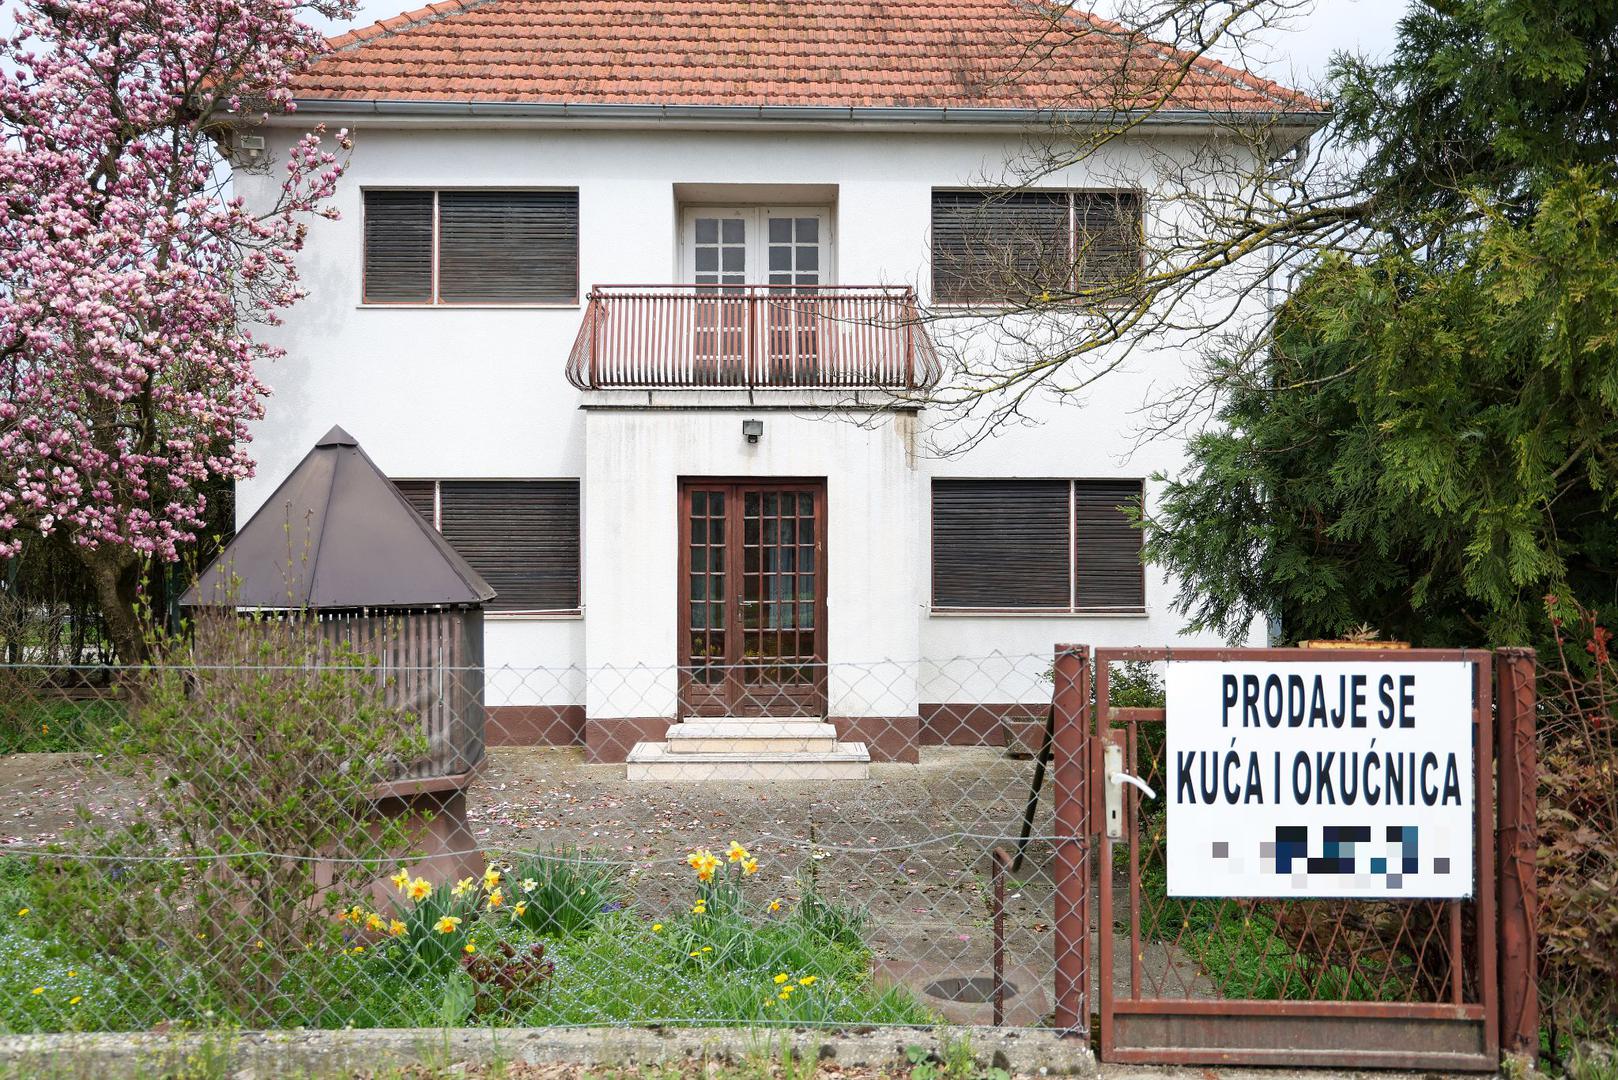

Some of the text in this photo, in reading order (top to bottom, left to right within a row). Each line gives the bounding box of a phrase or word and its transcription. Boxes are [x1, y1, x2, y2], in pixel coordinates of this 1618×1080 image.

[1221, 673, 1416, 730] PRODAJE SE
[1177, 736, 1463, 807] KUĆA I OKUĆNICA
